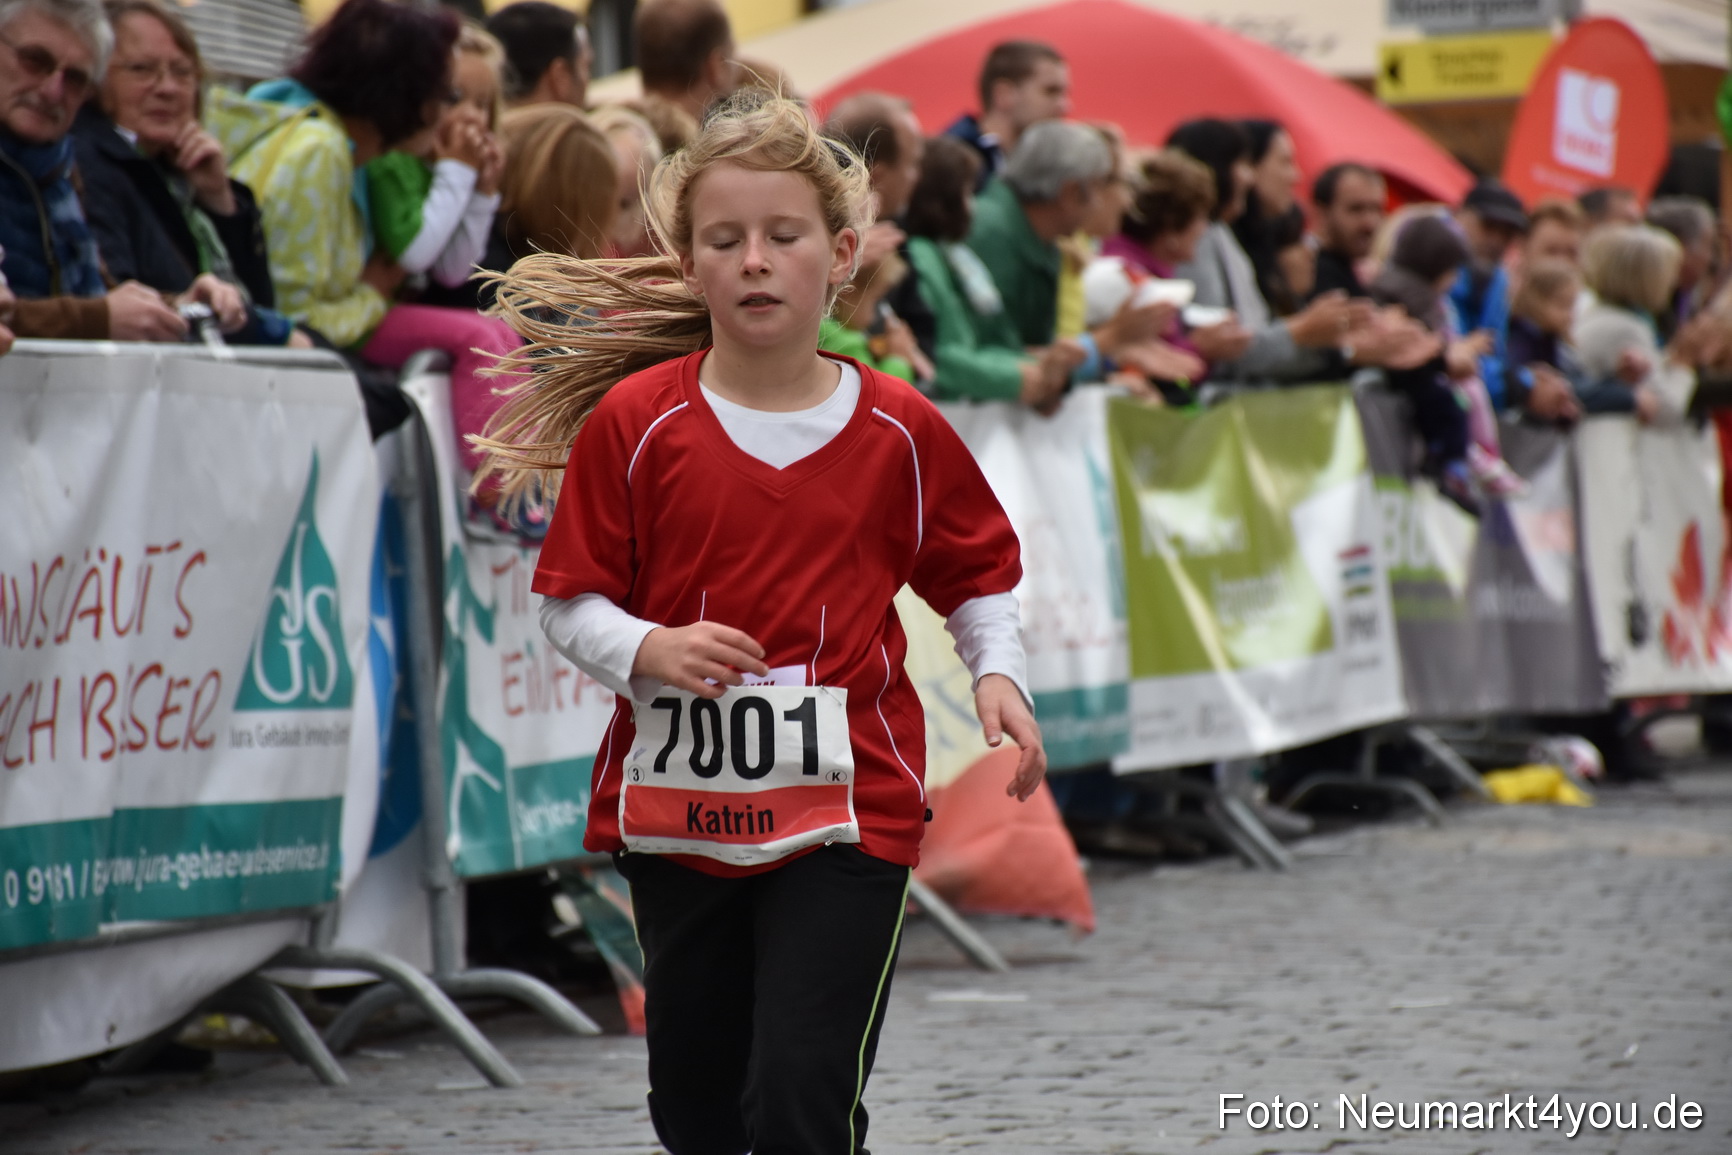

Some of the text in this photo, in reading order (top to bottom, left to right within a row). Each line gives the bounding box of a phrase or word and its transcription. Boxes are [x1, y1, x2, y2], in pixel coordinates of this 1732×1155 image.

[651, 696, 819, 780] 7001
[632, 767, 841, 782] 3 K
[686, 801, 775, 835] Katrin
[4, 868, 20, 909] 0
